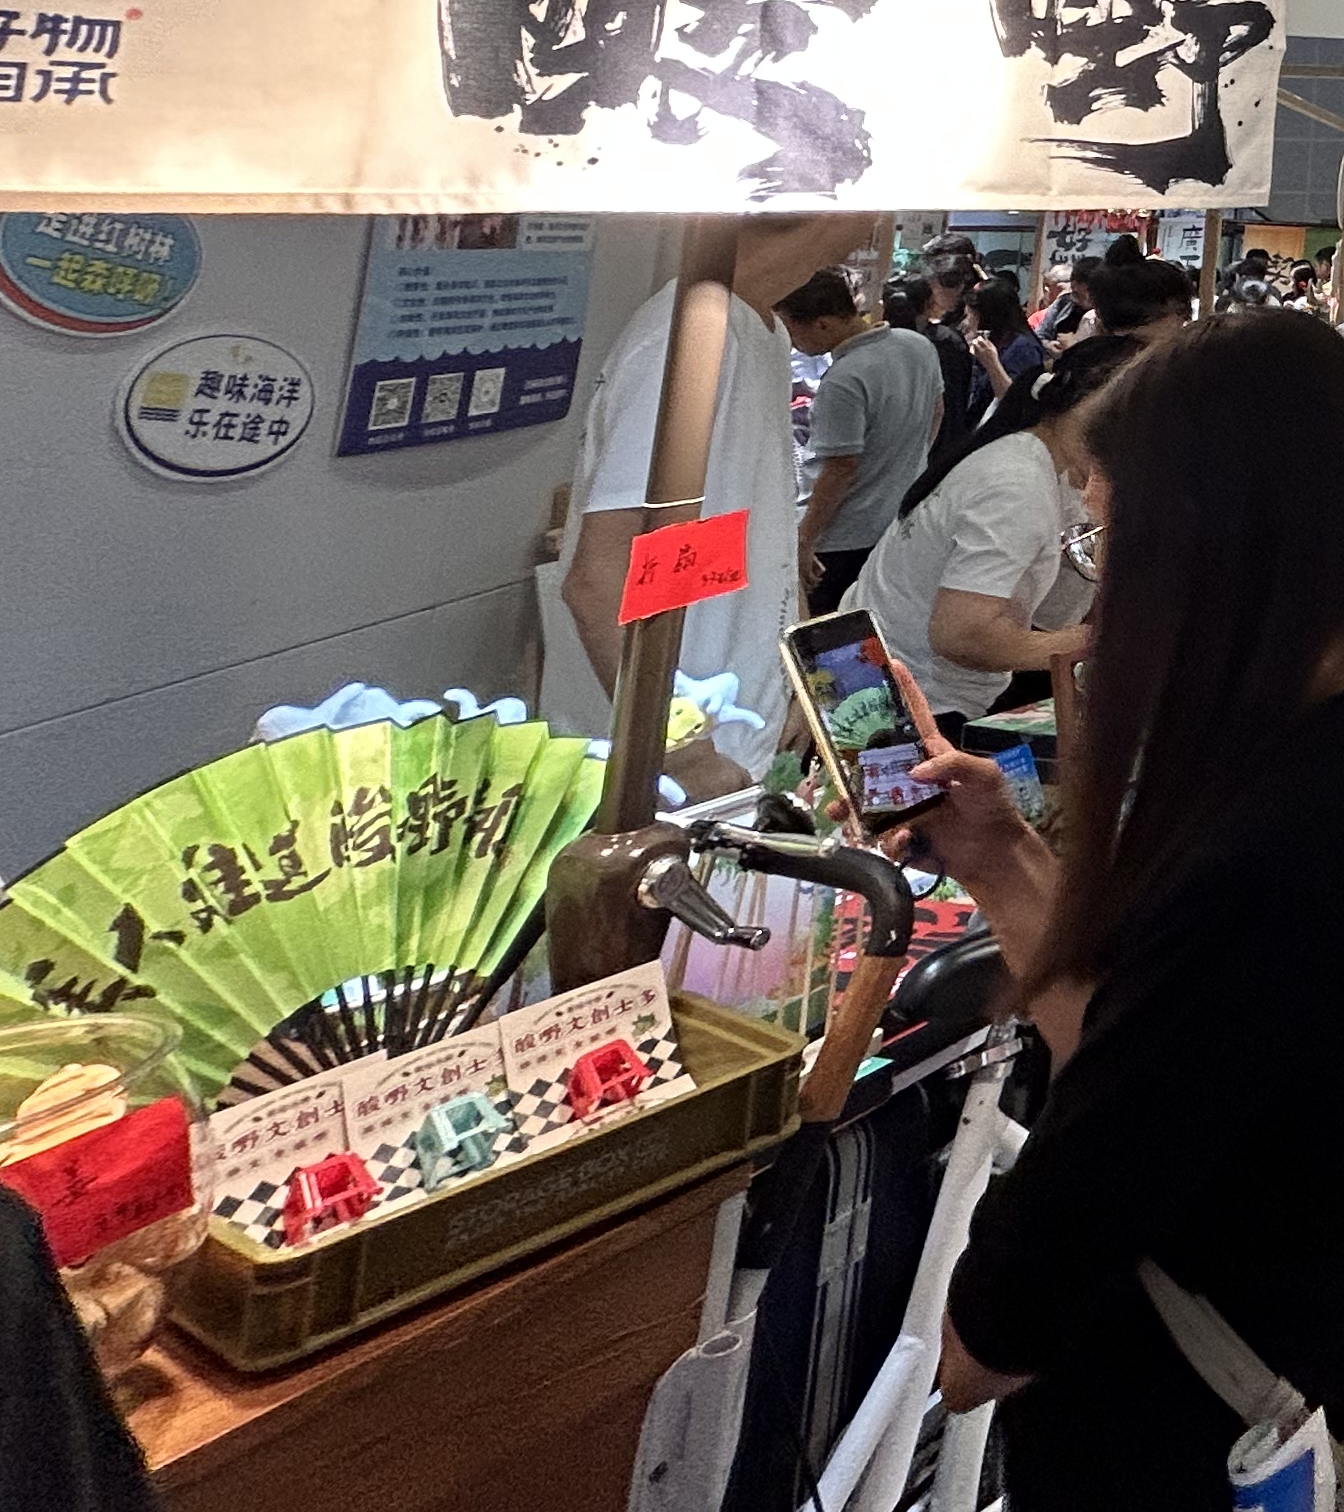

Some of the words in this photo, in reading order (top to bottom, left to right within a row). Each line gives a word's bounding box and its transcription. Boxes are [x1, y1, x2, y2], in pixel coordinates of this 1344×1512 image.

[194, 370, 303, 407] 趣味海洋
[184, 408, 291, 446] 乐在途中
